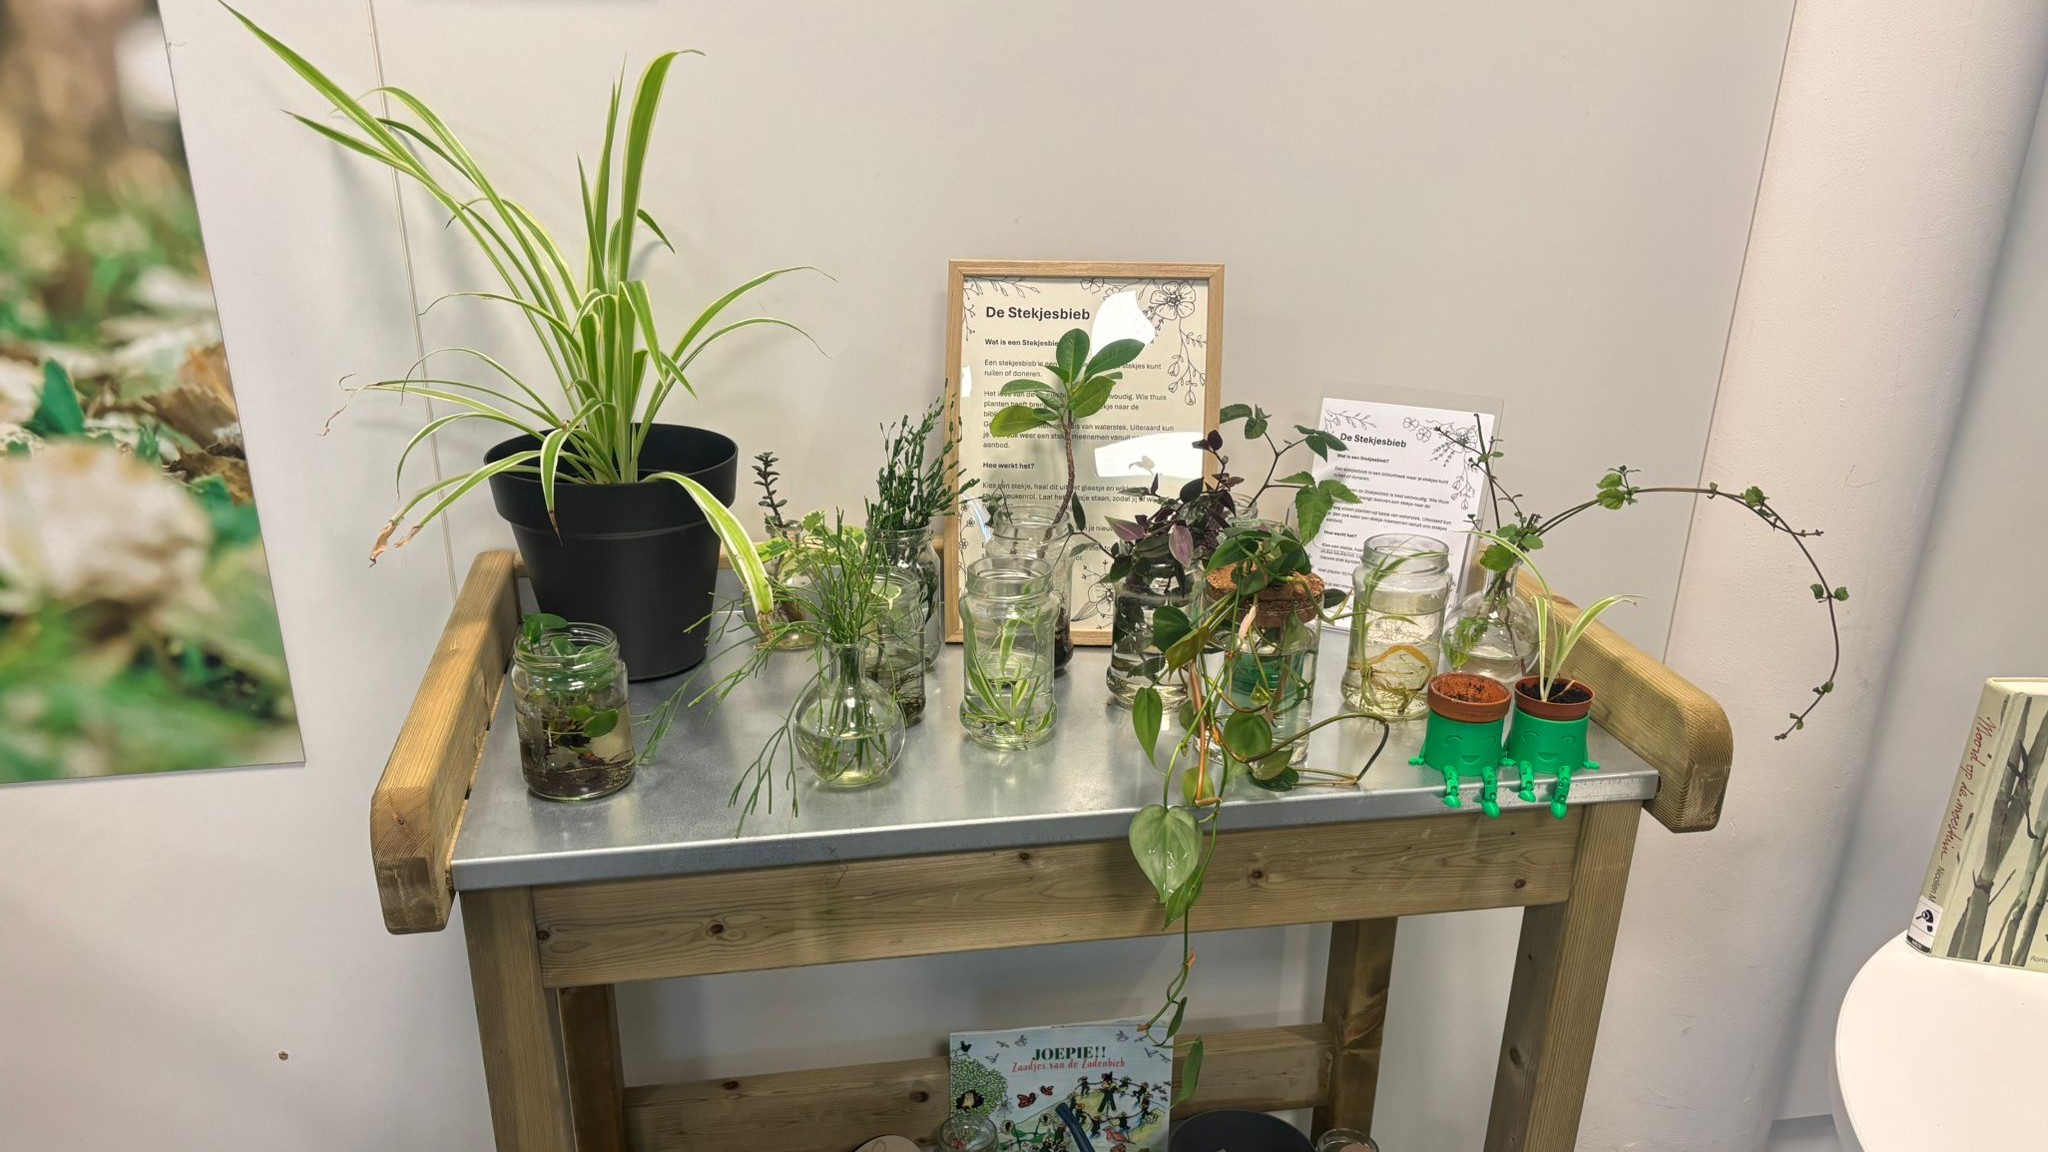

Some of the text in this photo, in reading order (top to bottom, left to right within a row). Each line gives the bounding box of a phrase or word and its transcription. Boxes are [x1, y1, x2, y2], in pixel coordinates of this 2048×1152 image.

[986, 306, 1090, 321] De Stekjesbieb
[1022, 339, 1058, 347] Stekjesbie
[1146, 362, 1162, 370] kunt
[1109, 393, 1134, 401] voudig.
[1135, 393, 1148, 401] Wie
[1340, 433, 1407, 448] De Stekjesbieb
[1011, 483, 1032, 491] stekje,
[1970, 716, 1997, 767] Moord
[1960, 764, 1975, 781] op
[1940, 799, 1965, 861] moestuin
[1032, 1046, 1106, 1061] JOEPIE!!
[1012, 1057, 1126, 1072] Zaadjes van de Zadenbieb
